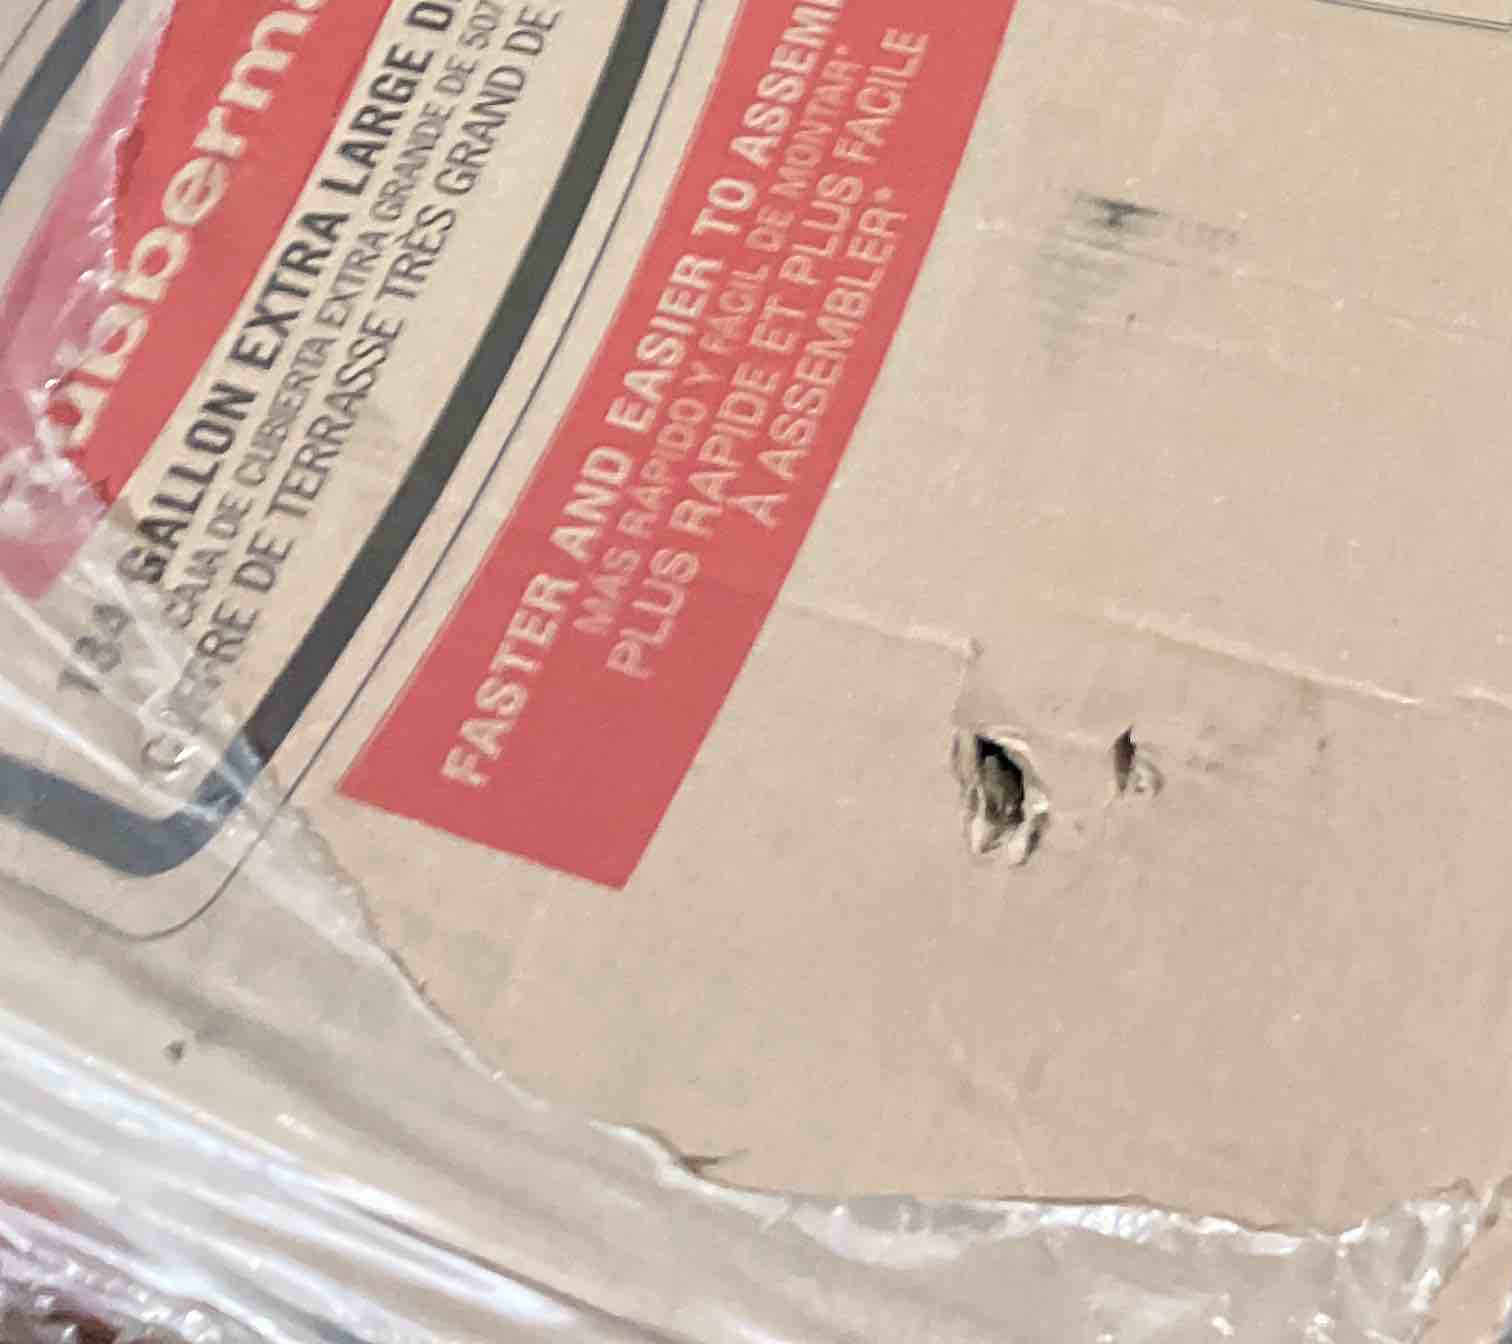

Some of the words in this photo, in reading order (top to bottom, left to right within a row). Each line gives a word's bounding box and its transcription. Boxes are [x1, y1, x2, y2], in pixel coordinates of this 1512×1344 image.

[115, 378, 259, 587] GALLON
[230, 208, 344, 373] EXTRA
[325, 40, 435, 206] LARGE
[203, 486, 250, 540] DE
[315, 228, 387, 329] EXTRA
[366, 85, 455, 227] GRANDE
[435, 35, 481, 95] DE
[231, 533, 293, 616] DE
[268, 302, 405, 526] TERRASSE
[390, 204, 458, 308] TRÈS
[434, 64, 528, 210] GRAND
[509, 0, 559, 67] DE
[440, 568, 579, 790] FASTER
[546, 443, 634, 565] AND
[608, 250, 725, 437] EASIER
[692, 173, 756, 242] TO
[608, 546, 702, 680] PLUS
[671, 368, 784, 539] RAPIDE
[752, 295, 805, 367] ET
[797, 154, 862, 293] PLUS
[854, 25, 929, 157] FACILE
[676, 358, 713, 391] Y
[747, 201, 796, 254] DE
